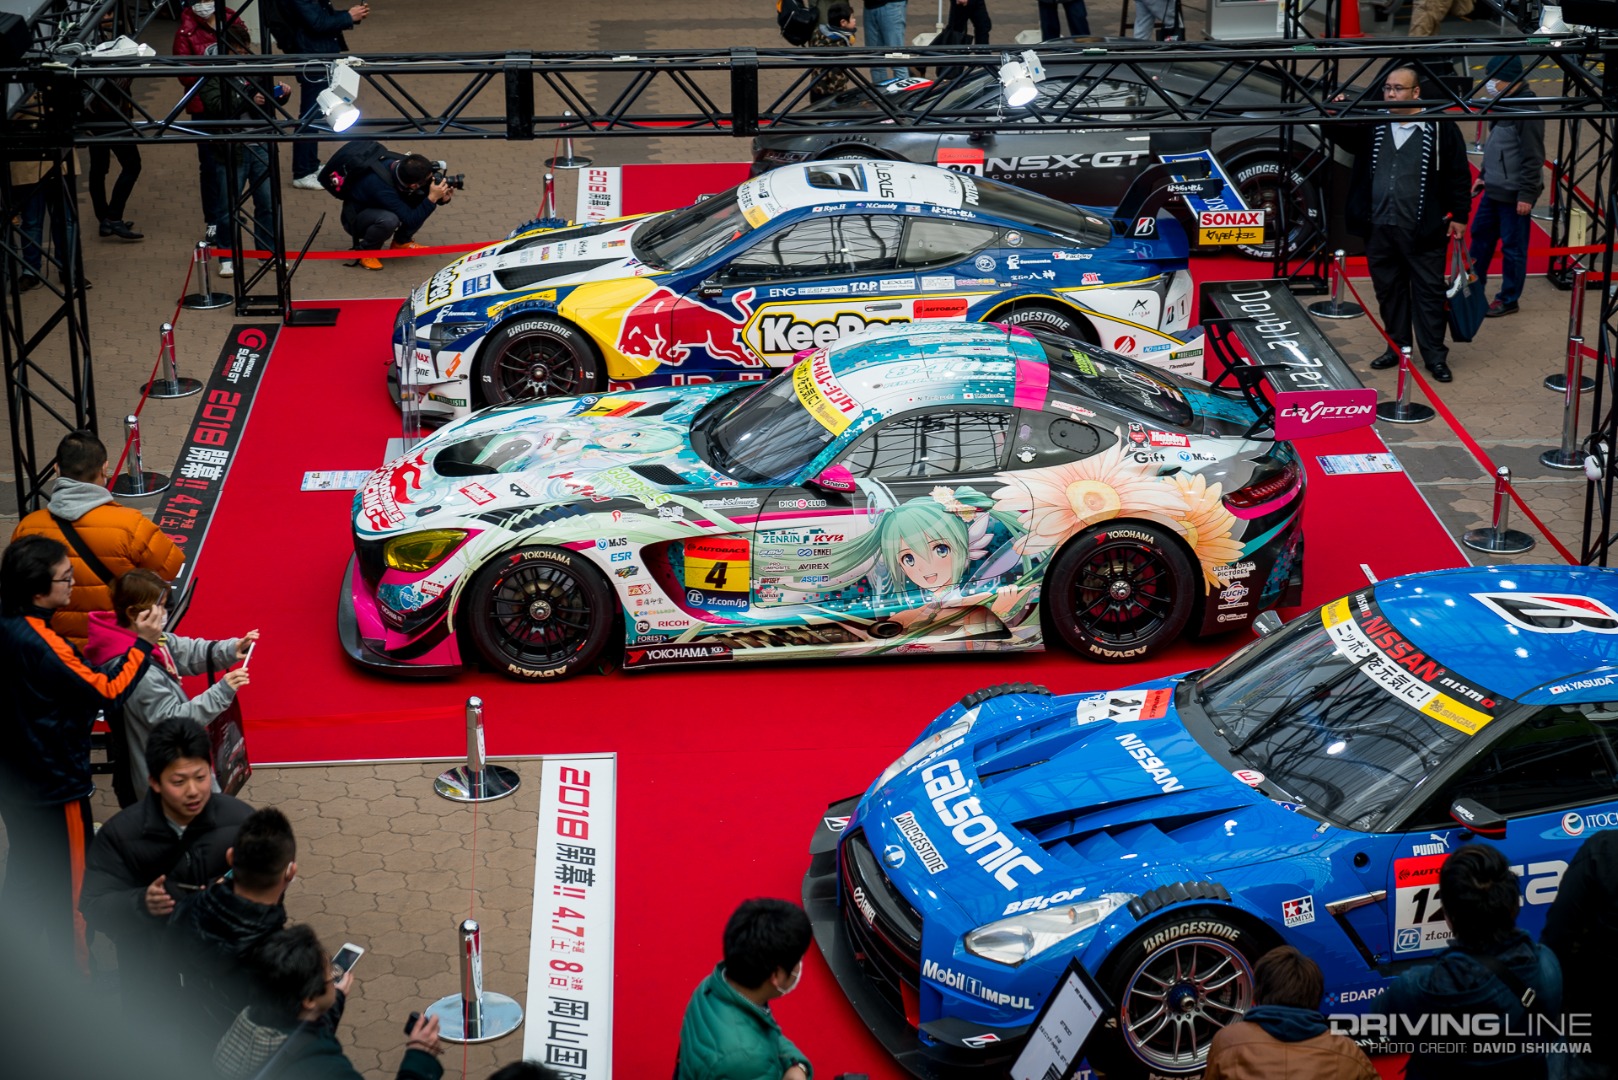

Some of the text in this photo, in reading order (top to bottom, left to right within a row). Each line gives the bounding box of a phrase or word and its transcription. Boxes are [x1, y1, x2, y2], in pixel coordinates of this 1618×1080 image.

[984, 151, 1141, 173] NSX-GT
[991, 171, 1077, 180] CONCEPT
[875, 168, 895, 199] LEXUS
[822, 203, 846, 213] Ryo.H
[1201, 212, 1259, 226] SONAX
[704, 287, 723, 295] CASIO
[770, 288, 796, 297] ENG
[1230, 290, 1300, 350] Double
[507, 321, 572, 338] BRIDGESTONE
[763, 312, 910, 352] KeeP
[231, 347, 250, 373] SUPER
[226, 369, 241, 384] GT
[1280, 401, 1372, 423] CRYPTON
[1151, 430, 1188, 446] Hobby
[1133, 451, 1166, 463] Gift
[608, 538, 627, 547] MJS
[762, 535, 800, 544] ZENRIN
[814, 534, 844, 542] KYB
[1107, 530, 1155, 544] YOKOHAMA
[610, 552, 632, 562] ESR
[697, 545, 746, 554] AUTOBACS
[522, 551, 571, 566] YOKOHAMA
[704, 562, 728, 589] 4
[1217, 568, 1248, 578] PICTURES
[689, 592, 702, 602] ZF
[1219, 586, 1249, 600] FUCHS
[707, 597, 748, 608] zf.com/jp
[1355, 593, 1371, 618] nismo
[647, 647, 709, 660] YOKOHAMA
[1089, 643, 1148, 658] ADVAN
[1360, 615, 1444, 682] NISSAN
[508, 662, 568, 678] ADVAN
[1440, 677, 1497, 709] nismo
[1561, 677, 1614, 694] H.YASUDA
[1441, 708, 1478, 731] SINGHA
[1115, 733, 1185, 794] NISSAN
[1585, 813, 1618, 828] ITOC
[895, 812, 946, 873] BRIDGESTONE
[1412, 843, 1445, 857] PUMA
[1412, 867, 1441, 877] AUTO
[1412, 887, 1446, 925] 12
[1284, 912, 1314, 925] TAMIYA
[1143, 921, 1241, 954] BRIDGESTONE
[1399, 930, 1418, 946] ZF
[922, 958, 965, 991] Mobil
[981, 986, 1035, 1010] IMPUL
[1339, 986, 1386, 1004] EDARA
